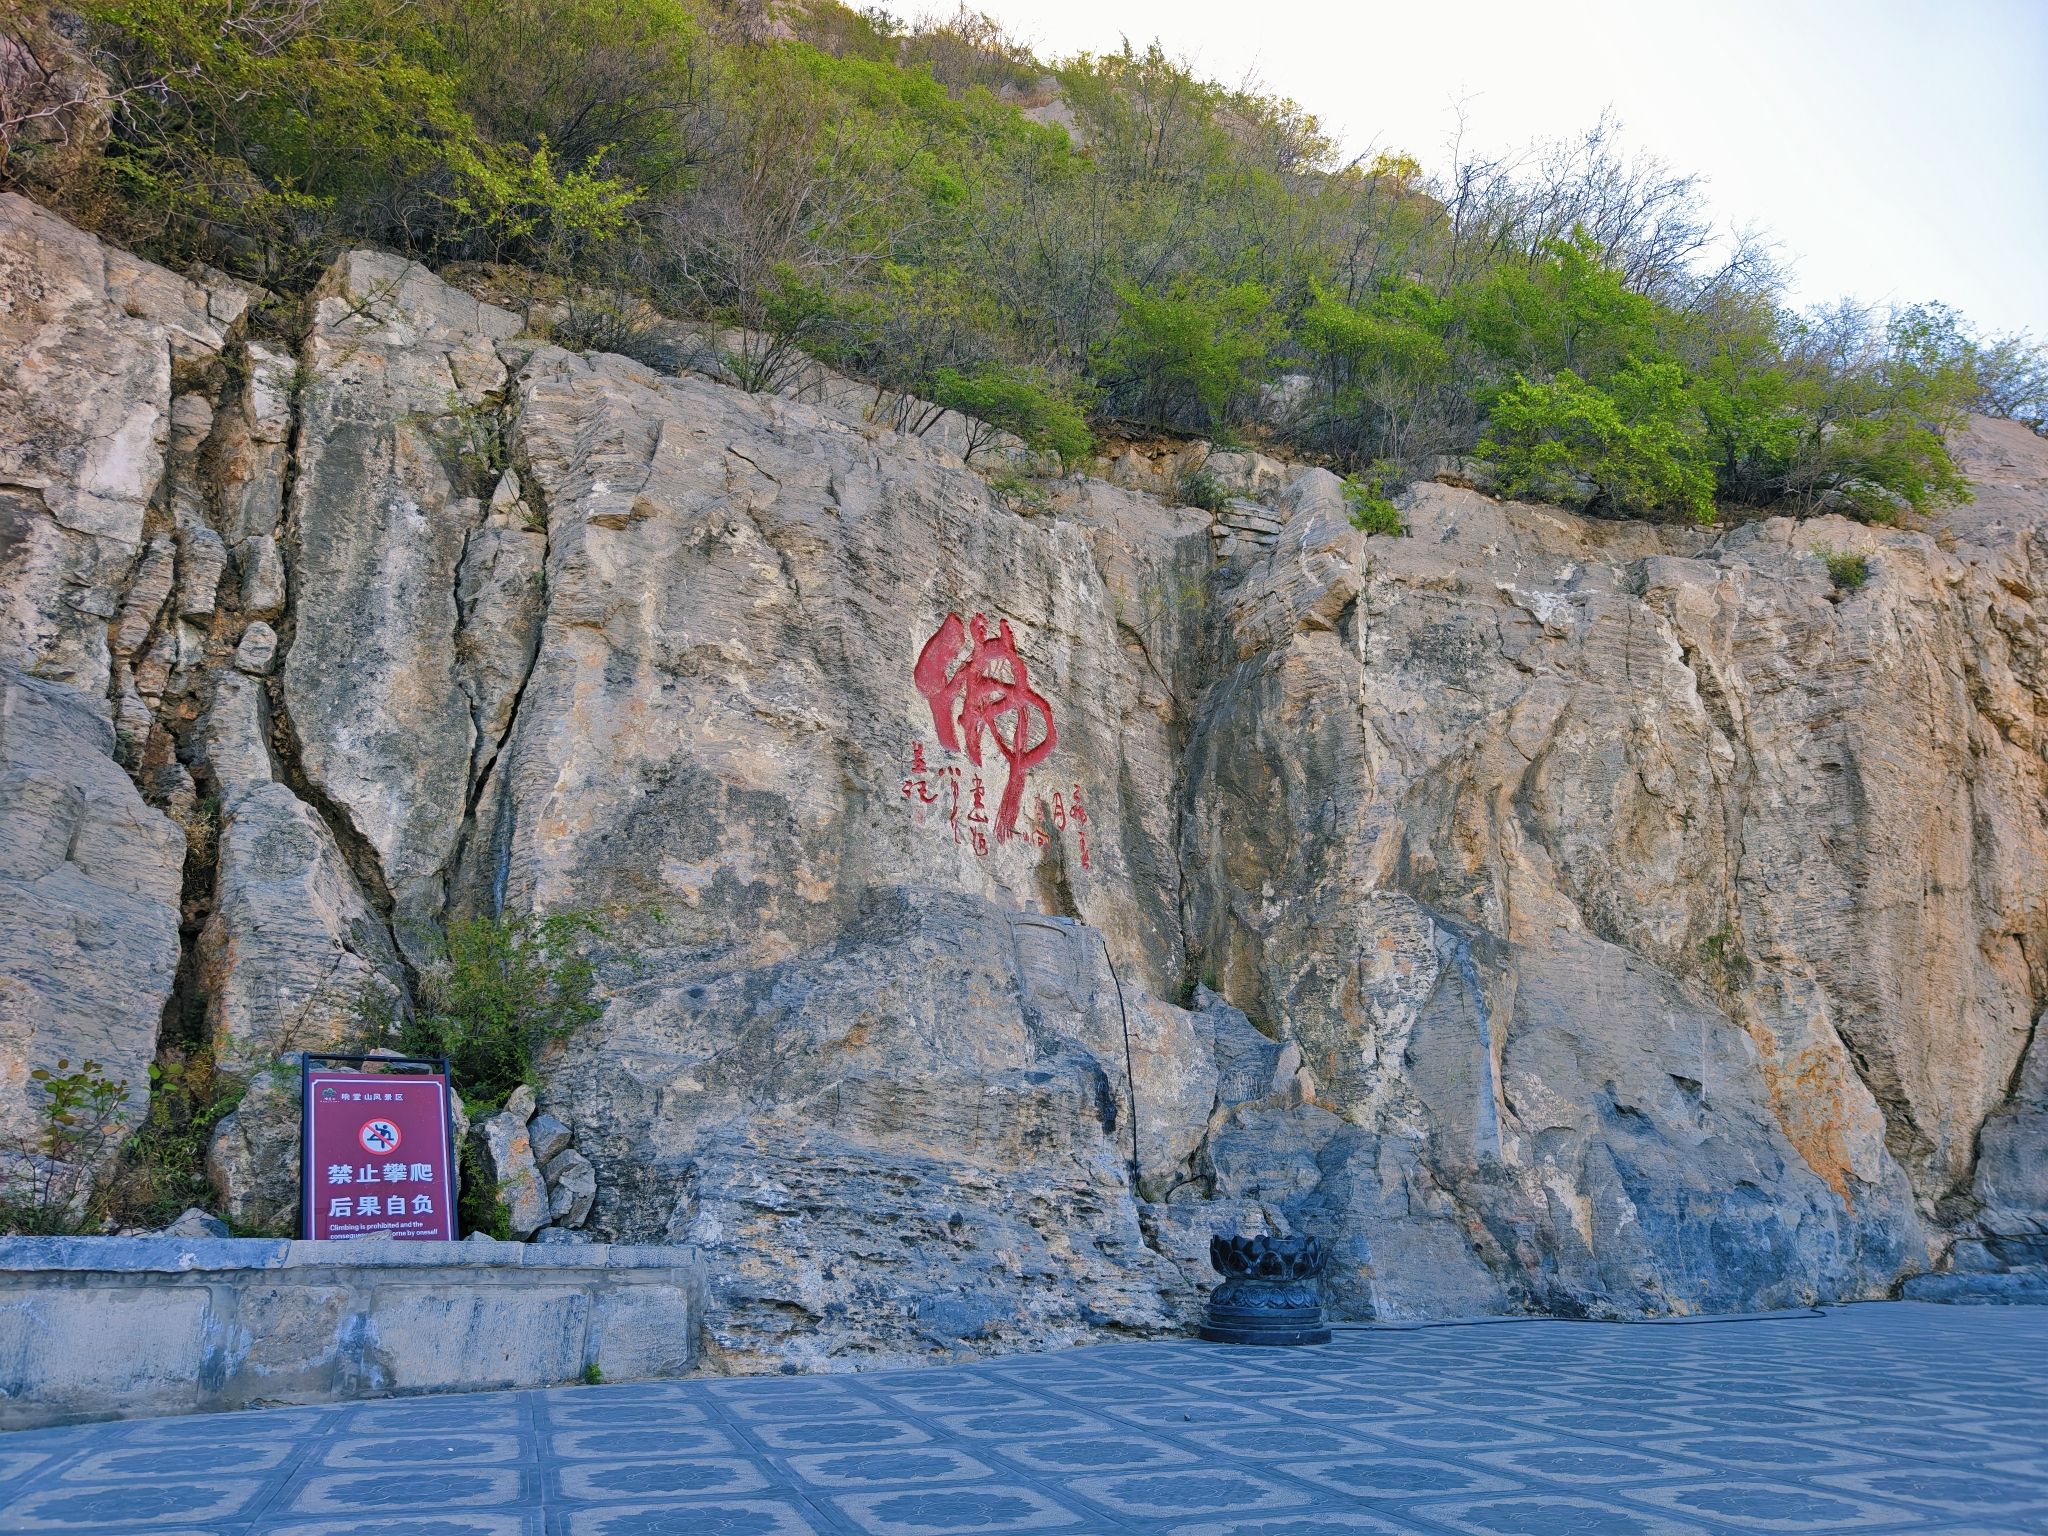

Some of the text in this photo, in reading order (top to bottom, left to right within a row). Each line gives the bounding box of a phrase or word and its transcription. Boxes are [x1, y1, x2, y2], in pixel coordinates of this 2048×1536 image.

[341, 1093, 404, 1101] 响堂山风景区
[327, 1162, 433, 1185] 禁止攀爬
[328, 1194, 434, 1217] 后果自负
[329, 1223, 359, 1231] Climbing
[366, 1222, 399, 1230] prohibited
[407, 1229, 415, 1237] by
